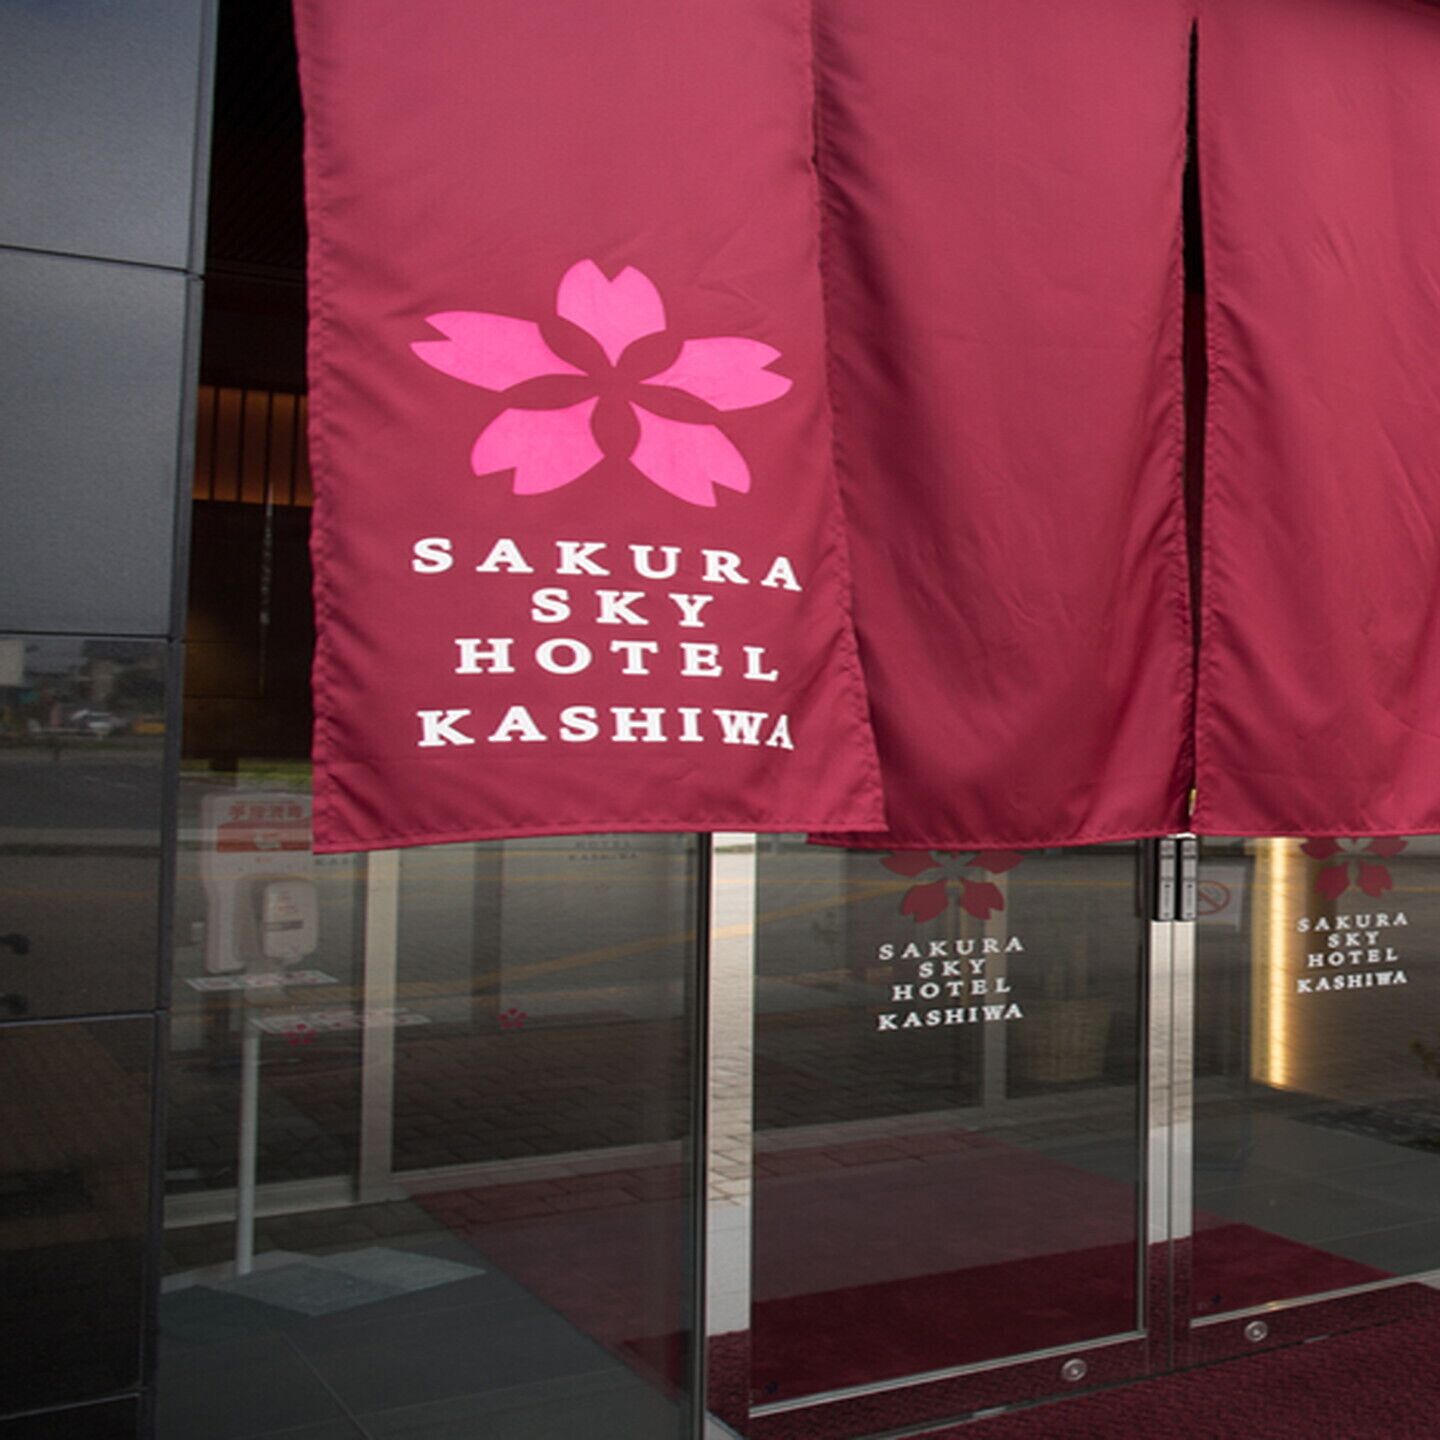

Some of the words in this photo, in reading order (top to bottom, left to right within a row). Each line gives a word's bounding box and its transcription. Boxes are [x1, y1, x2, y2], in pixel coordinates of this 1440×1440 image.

[412, 537, 802, 592] SAKURA
[531, 587, 714, 628] SKY
[454, 638, 779, 682] HOTEL
[416, 705, 795, 750] KASHIWA
[1297, 912, 1409, 932] SAKURA
[878, 936, 1024, 960] SAKURA
[1327, 931, 1381, 948] SKY
[918, 958, 987, 978] SKY
[1307, 947, 1399, 968] HOTEL
[892, 976, 1011, 1001] HOTEL
[1296, 970, 1408, 993] KASHIWA
[877, 1003, 1024, 1031] KASHIWA
